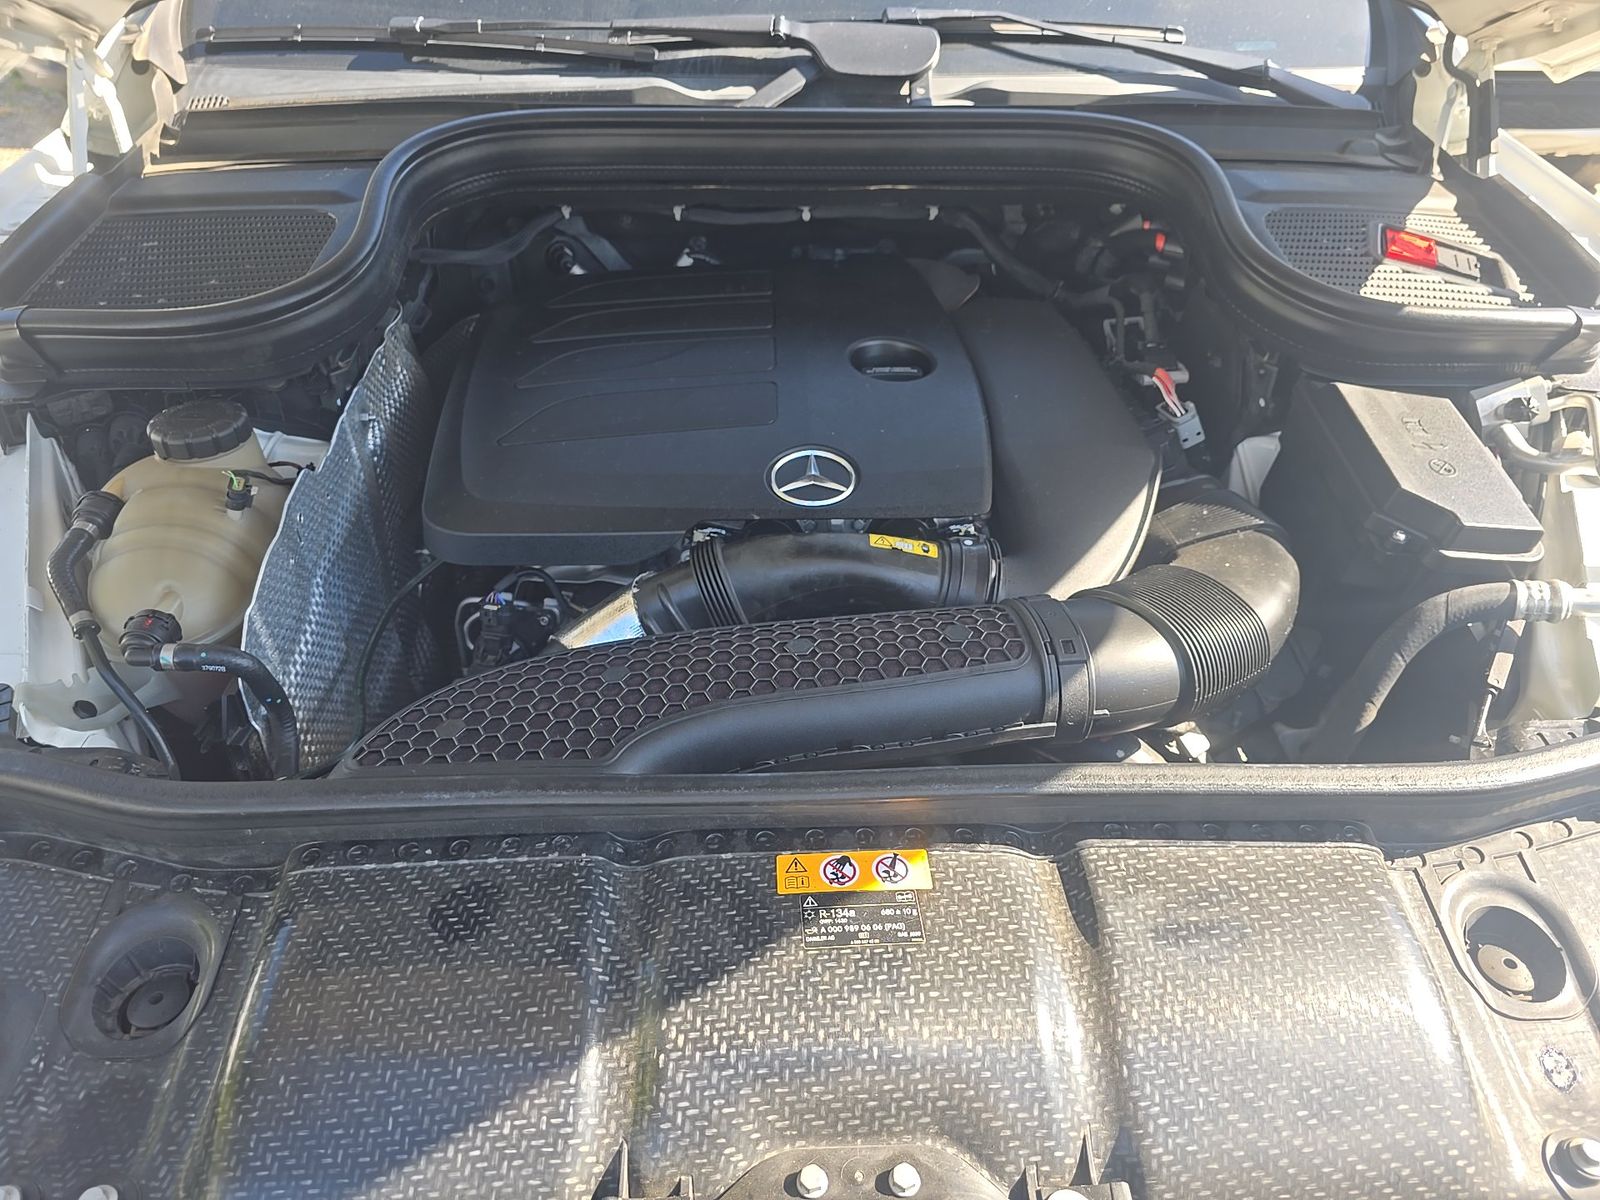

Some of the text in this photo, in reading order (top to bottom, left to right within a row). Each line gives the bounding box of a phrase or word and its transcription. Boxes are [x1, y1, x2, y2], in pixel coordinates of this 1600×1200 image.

[819, 908, 856, 918] R-134a
[881, 908, 895, 916] 680
[903, 907, 912, 915] 10
[827, 925, 843, 933] 000
[844, 924, 859, 932] 989
[872, 923, 883, 931] 06
[884, 922, 906, 931] (PAG)
